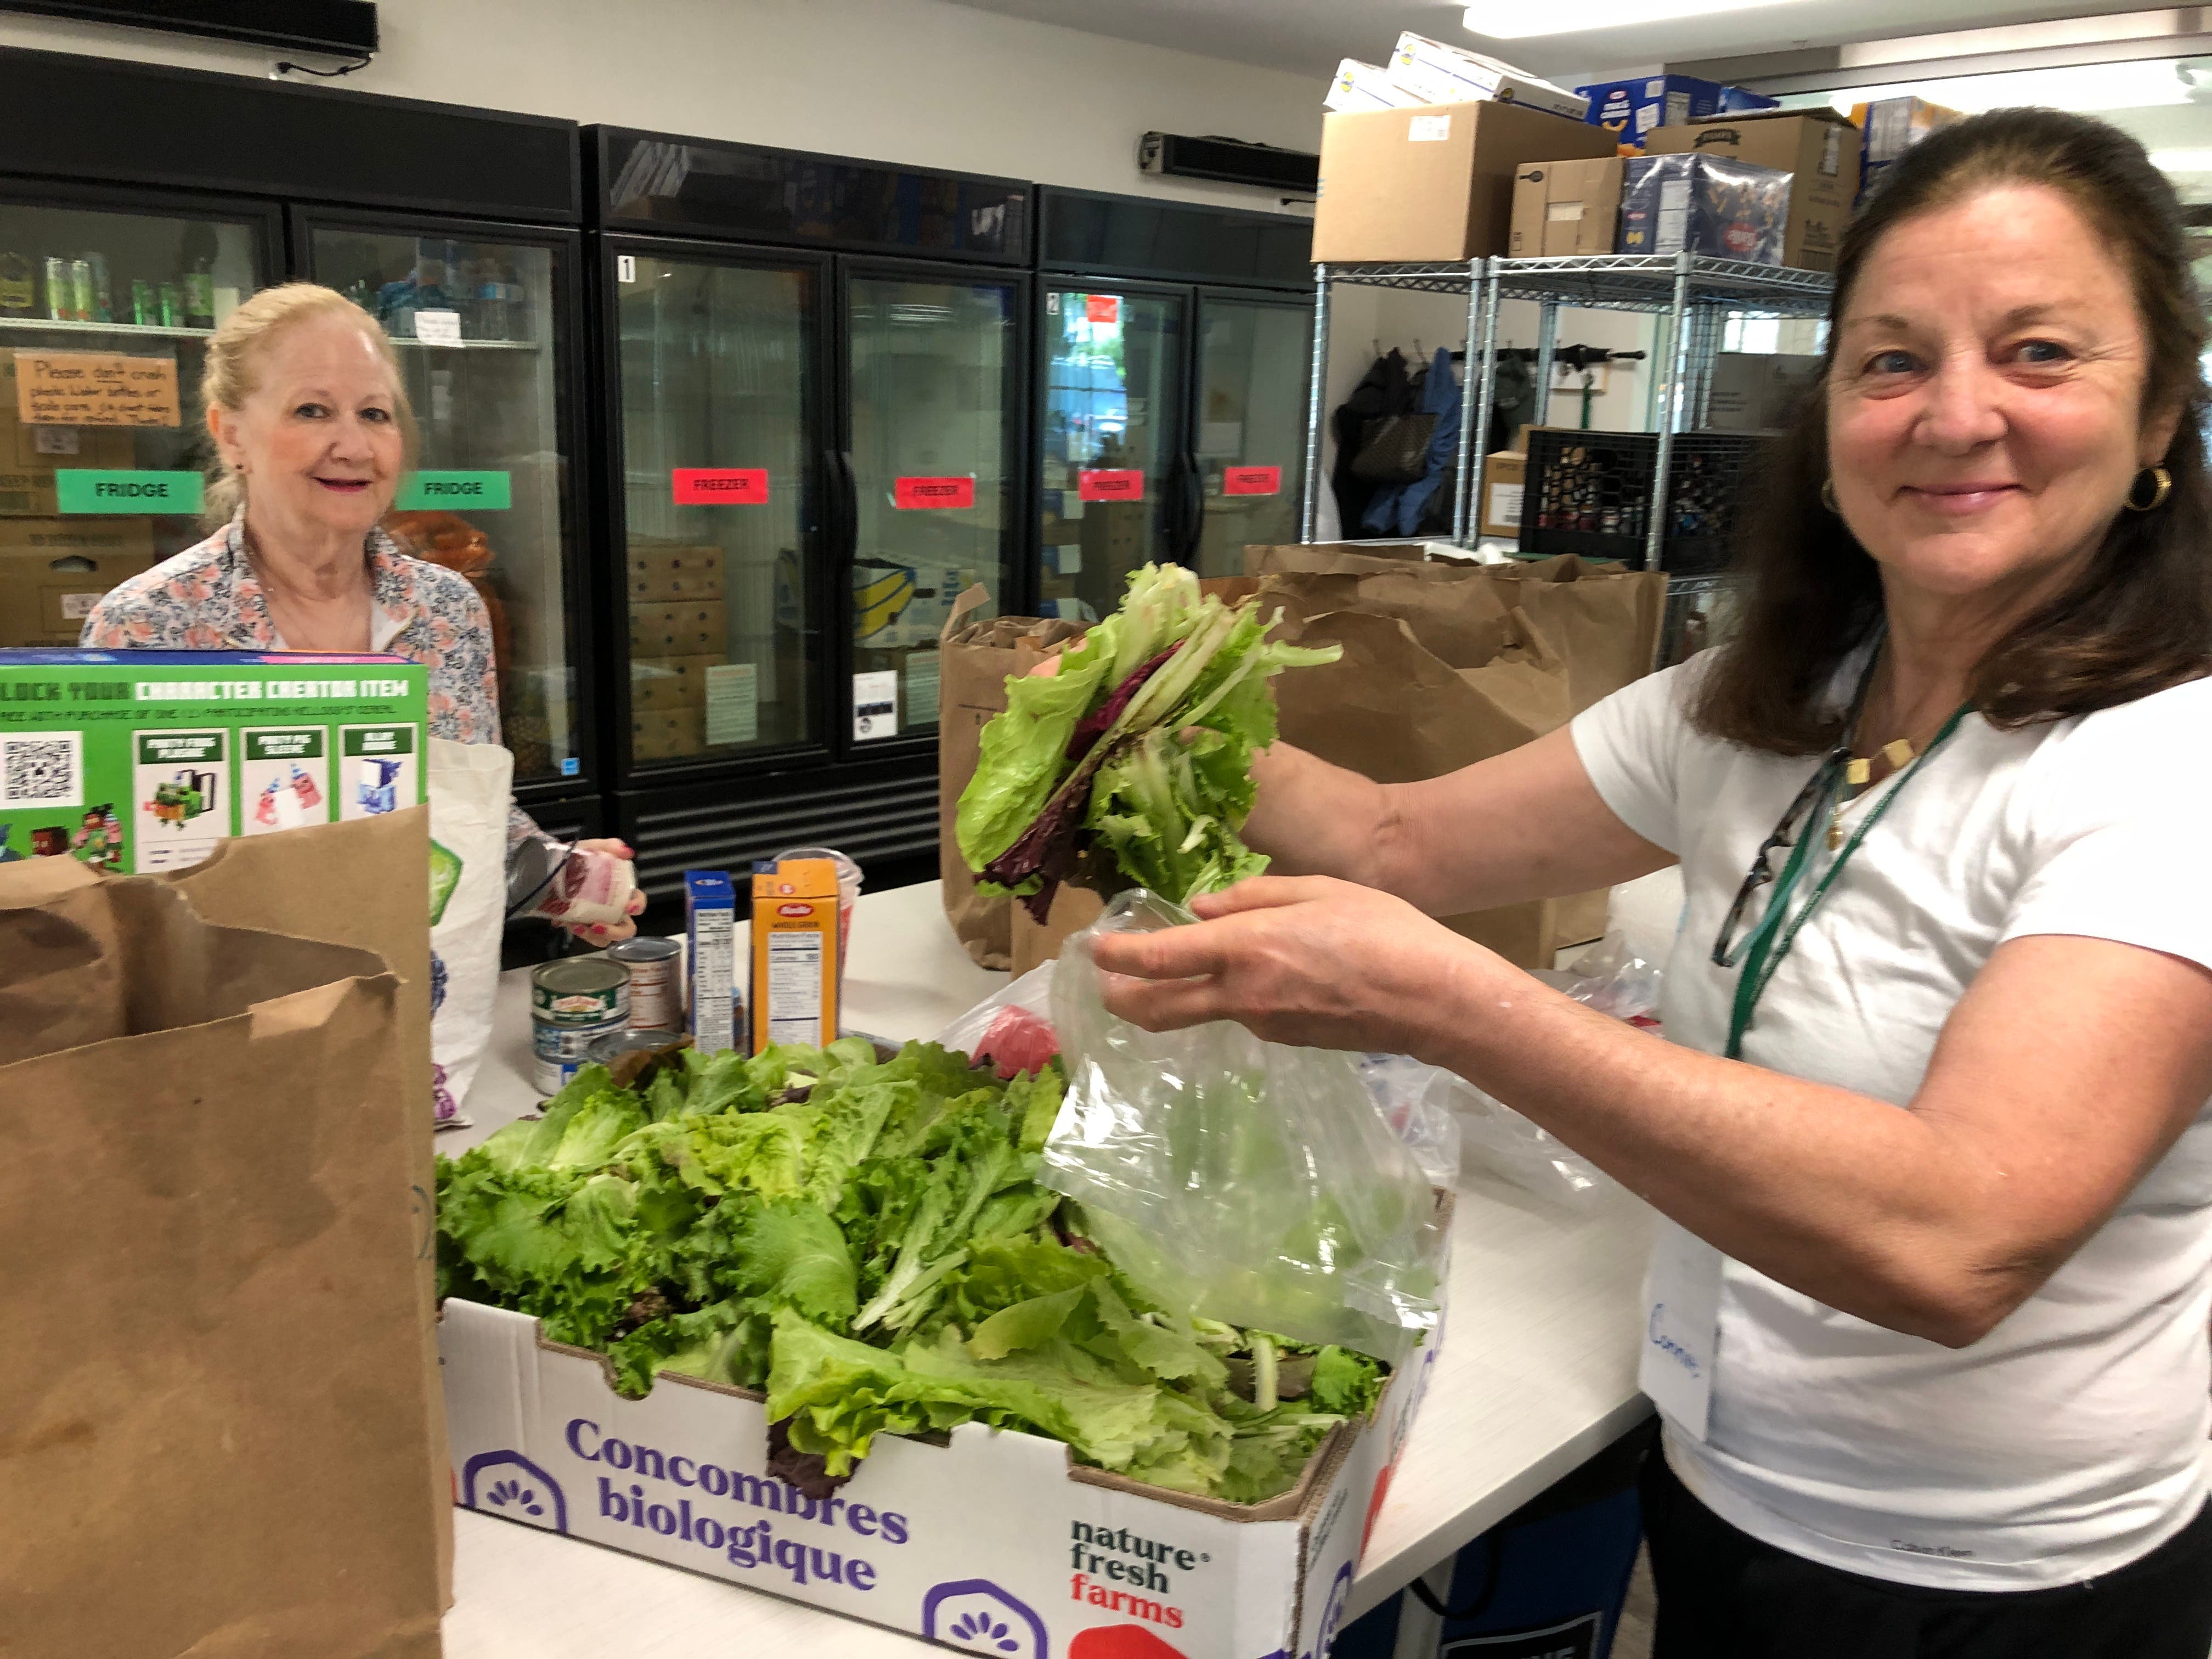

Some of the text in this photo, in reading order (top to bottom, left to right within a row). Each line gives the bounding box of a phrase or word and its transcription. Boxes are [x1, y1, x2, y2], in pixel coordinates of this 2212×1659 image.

[95, 482, 169, 498] FRIDGE
[424, 482, 483, 495] FRIDGE
[693, 478, 750, 490] FREEZER
[913, 486, 958, 496] FREEZER
[135, 680, 262, 701] CHARACTER
[266, 680, 357, 699] CREATOR
[359, 679, 409, 697] ITEM
[597, 1476, 877, 1592] biologique
[1068, 1542, 1170, 1594] fresh
[1069, 1572, 1185, 1629] farms
